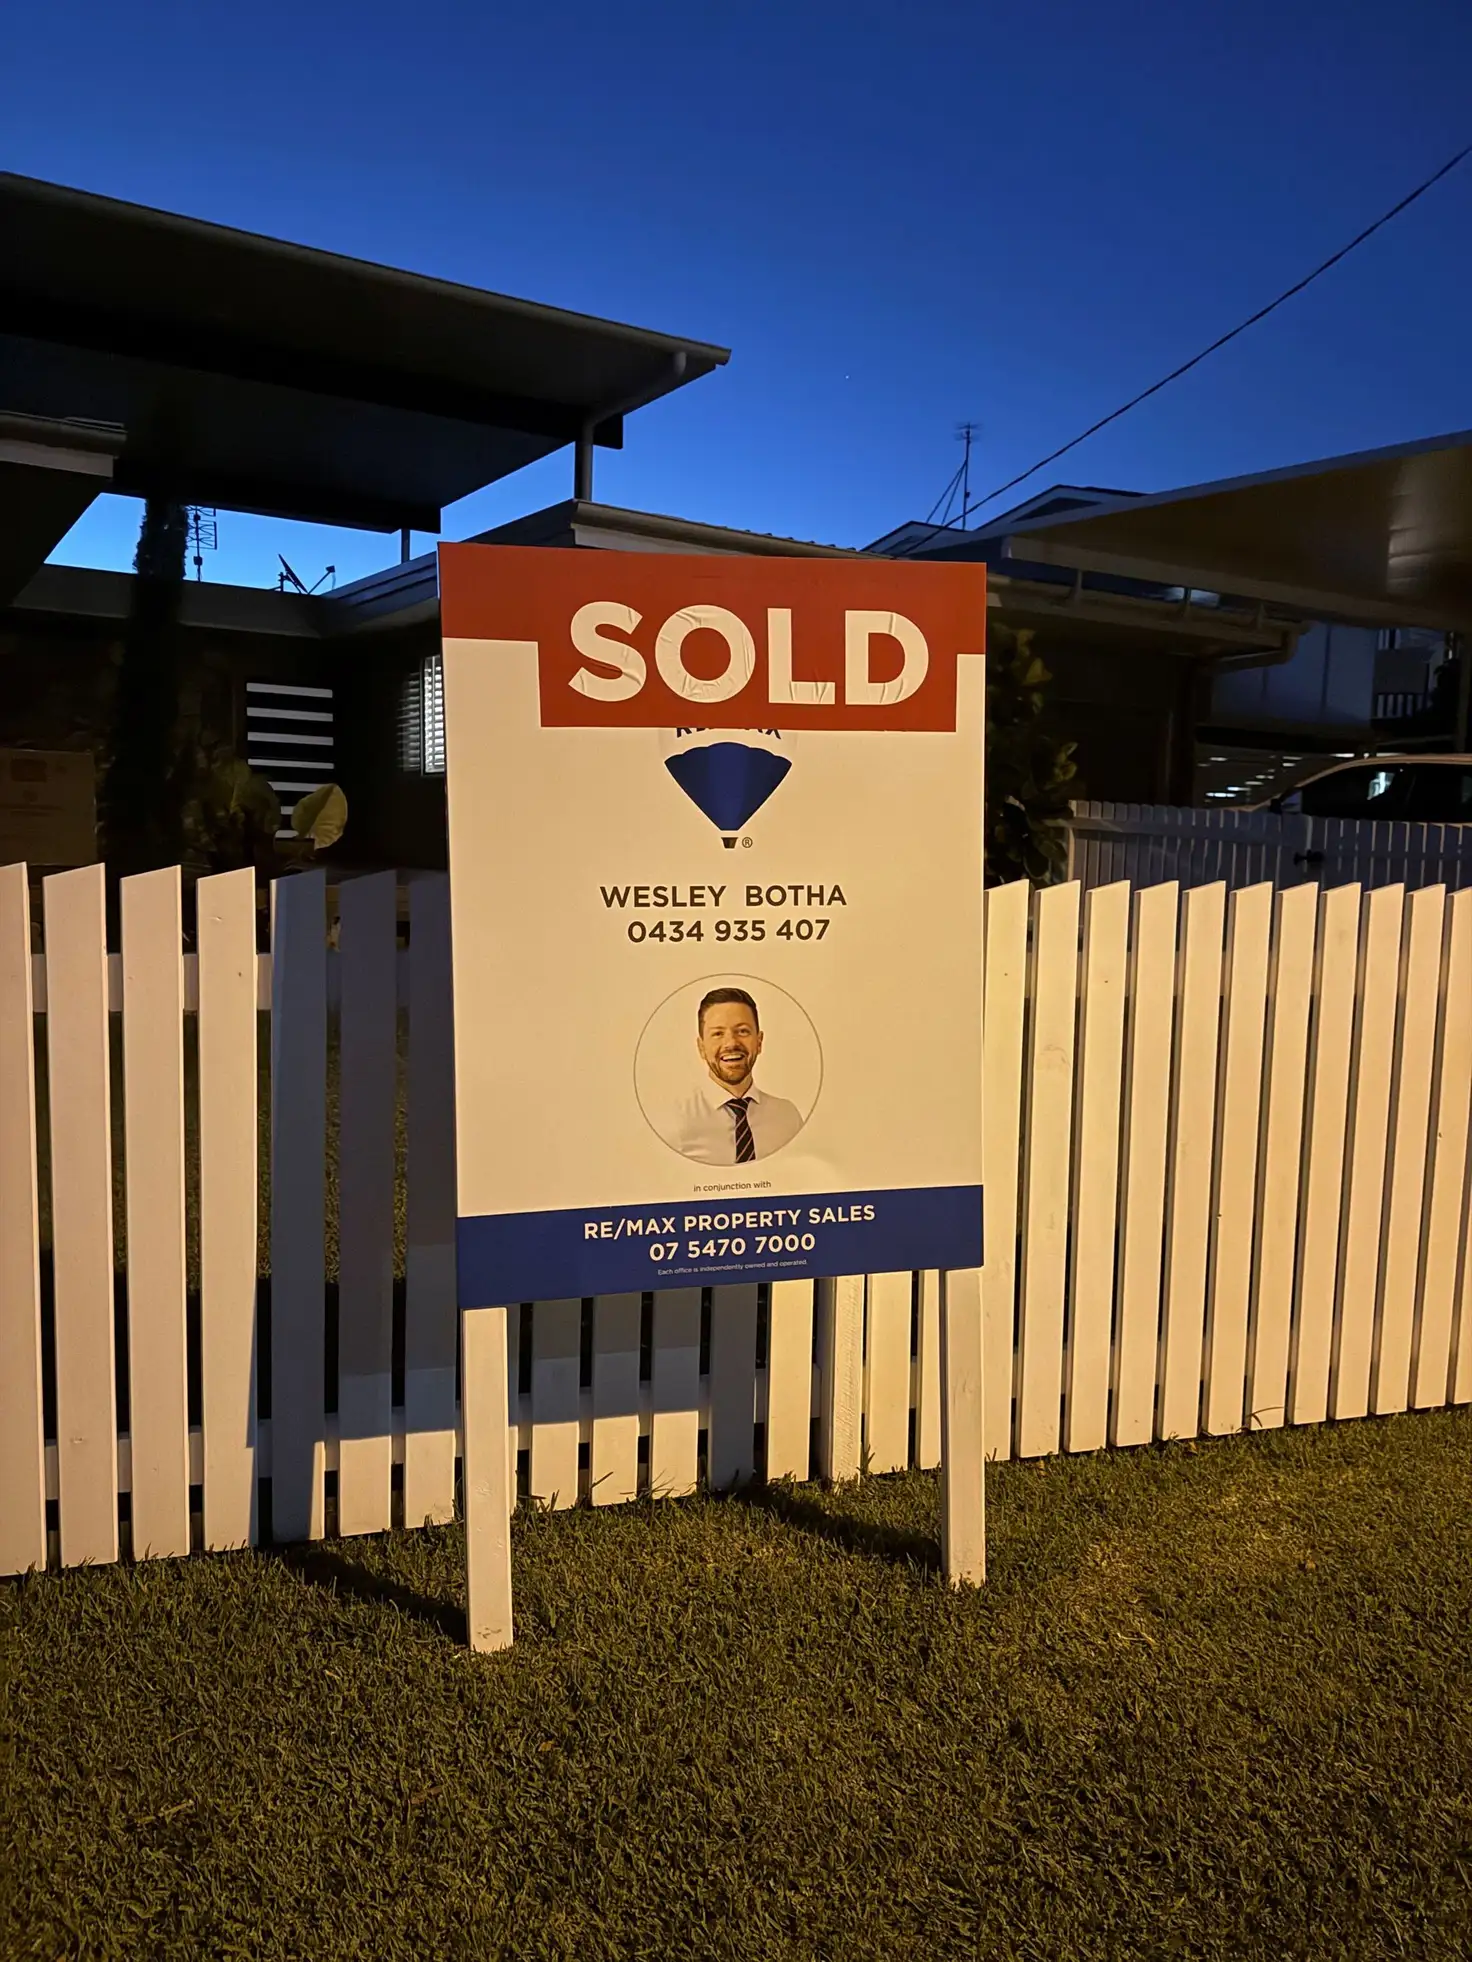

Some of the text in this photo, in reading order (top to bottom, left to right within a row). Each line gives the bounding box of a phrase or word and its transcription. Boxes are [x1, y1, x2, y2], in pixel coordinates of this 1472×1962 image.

[568, 600, 930, 706] SOLD
[600, 884, 847, 908] WESLEY BOTHA
[627, 919, 830, 943] 0434 935 407
[693, 1180, 772, 1192] in conjunction with
[584, 1204, 876, 1240] RE/MAX PROPERTY SALES
[649, 1233, 816, 1262] 07 5470 7000
[657, 1268, 674, 1276] Each
[674, 1267, 692, 1275] office
[699, 1263, 744, 1273] independently
[745, 1261, 766, 1270] owned
[766, 1260, 778, 1268] and
